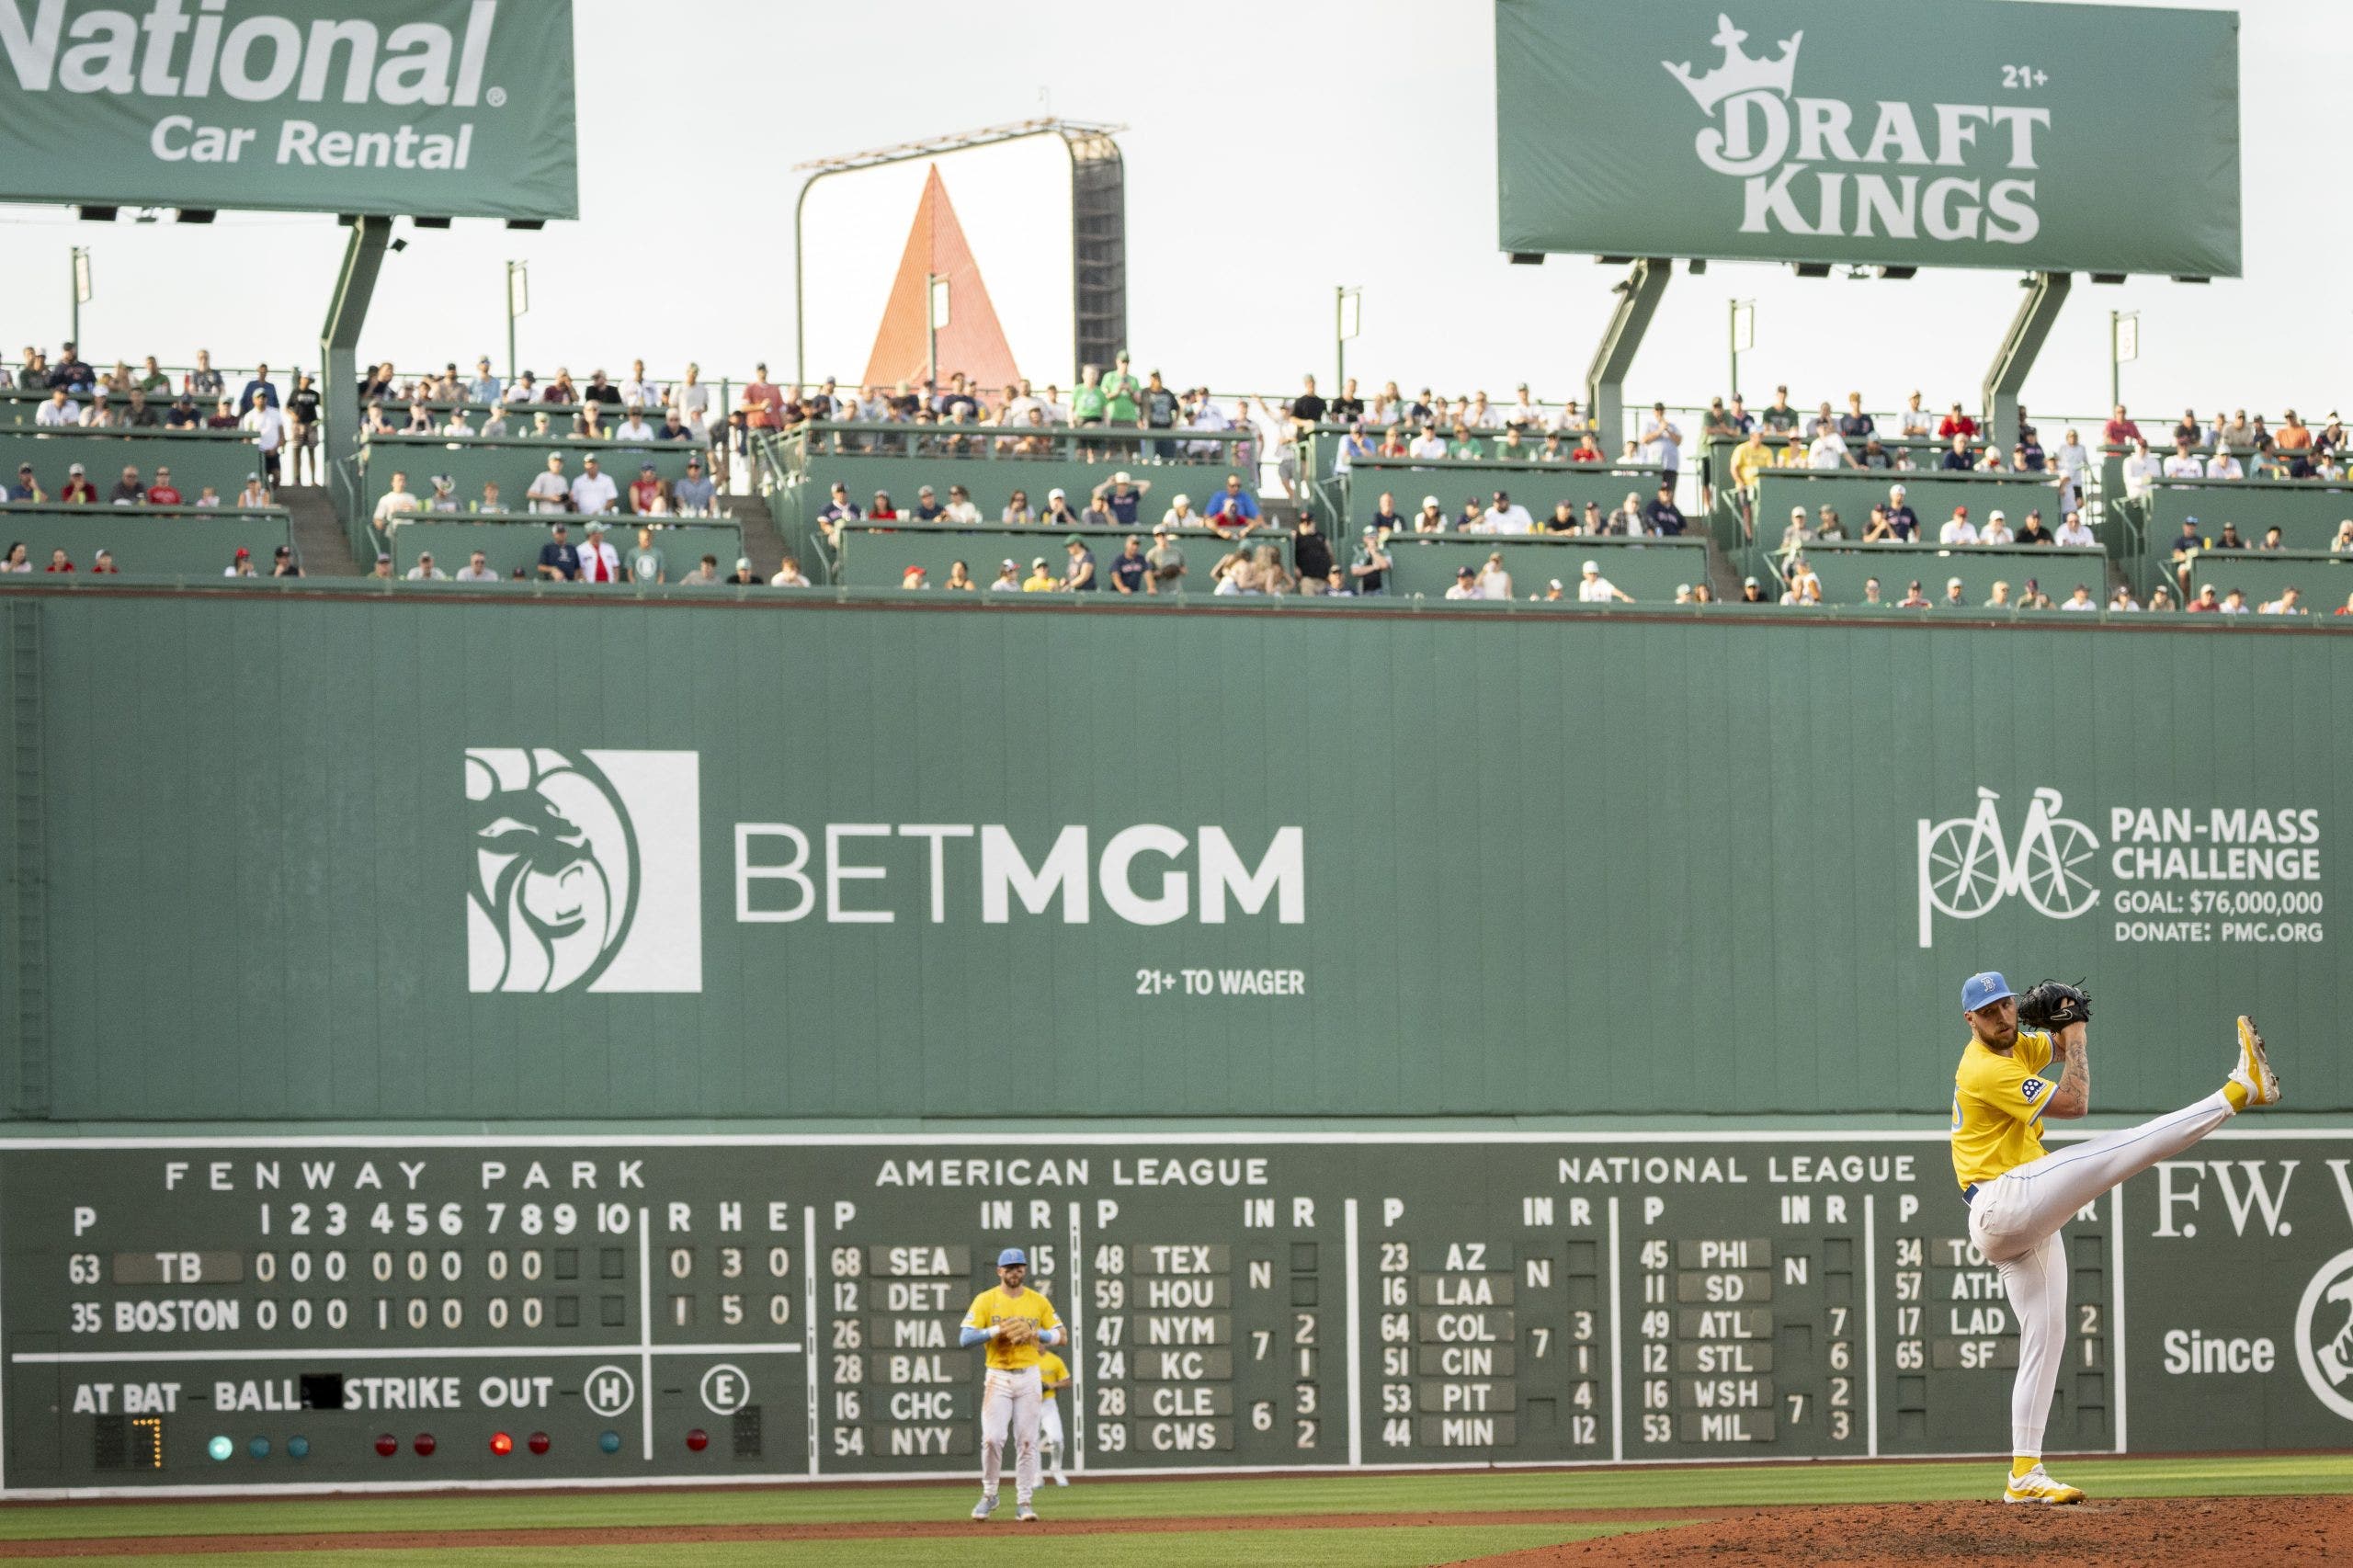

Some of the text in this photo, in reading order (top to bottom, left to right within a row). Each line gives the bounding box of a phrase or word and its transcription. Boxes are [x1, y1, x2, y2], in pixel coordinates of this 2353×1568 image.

[2001, 64, 2048, 89] 21+
[151, 115, 473, 170] Car Rental
[1693, 87, 2052, 176] DRAFT
[1739, 162, 2040, 244] KINGS
[2110, 807, 2320, 844] PAN-MASS
[734, 823, 1305, 926] BETMGM
[2111, 846, 2321, 881] CHALLENGE
[2113, 889, 2324, 917] GOAL: $76,000,000
[2115, 921, 2324, 943] DONATE: PMC.ORG
[1136, 969, 1305, 995] 21+ TO WAGER
[165, 1160, 644, 1191] FENWAY PARK
[876, 1158, 1268, 1187] AMERICAN LEAGUE
[1558, 1155, 1915, 1184] NATIONAL LEAGUE
[74, 1201, 788, 1237] P 2 3 4 5 6 7 8 9 10 R H E
[835, 1199, 1051, 1231] P IN R
[1097, 1197, 1315, 1229] P IN R
[1383, 1197, 1592, 1227] P IN R
[1644, 1195, 1847, 1225] P IN R
[1900, 1194, 1919, 1223] P
[69, 1254, 100, 1284] 63
[155, 1252, 202, 1283] TB
[722, 1248, 742, 1278] 3
[831, 1245, 1055, 1277] 68 SEA 15
[1095, 1244, 1271, 1290] 48 TEX N
[1380, 1243, 1550, 1288] 23 AZ N
[1640, 1240, 1807, 1285] 45 PHI N
[1895, 1238, 1923, 1267] 34
[835, 1282, 951, 1312] 12 DET
[1095, 1279, 1214, 1310] 59 HOU
[1382, 1277, 1493, 1306] 16 LAA
[1706, 1274, 1745, 1301] SD
[1895, 1270, 2006, 1301] 57 ATH
[71, 1302, 102, 1333] 35
[115, 1299, 240, 1333] BOSTON
[722, 1295, 743, 1324] 5
[1641, 1308, 1847, 1339] 49 ATL 7
[1898, 1305, 2097, 1336] 17 LAD 2
[833, 1319, 946, 1349] 26 MIA
[1096, 1314, 1315, 1360] 47 NYM 7 2
[1381, 1311, 1593, 1358] 64 COL 7 3
[1097, 1350, 1203, 1380] 24 KC
[1384, 1347, 1492, 1377] 51 CIN
[1643, 1342, 1848, 1373] 12 STL 6
[1896, 1340, 1996, 1369] 65 SF
[2164, 1329, 2276, 1375] Since
[834, 1354, 952, 1384] 28 BAL
[73, 1376, 553, 1414] AT BAT BALL STRIKE OUT
[835, 1391, 953, 1420] 16 CHC
[1097, 1385, 1316, 1431] 28 CLE 6 3
[1382, 1381, 1592, 1413] 53 PIT 4
[1644, 1378, 1848, 1424] 16 WSH 7 2
[835, 1426, 952, 1456] 54 NYY
[1097, 1420, 1315, 1452] 59 CWS 2
[1382, 1415, 1596, 1448] 44 MIN 12
[1643, 1411, 1849, 1443] 53 MIL 3
